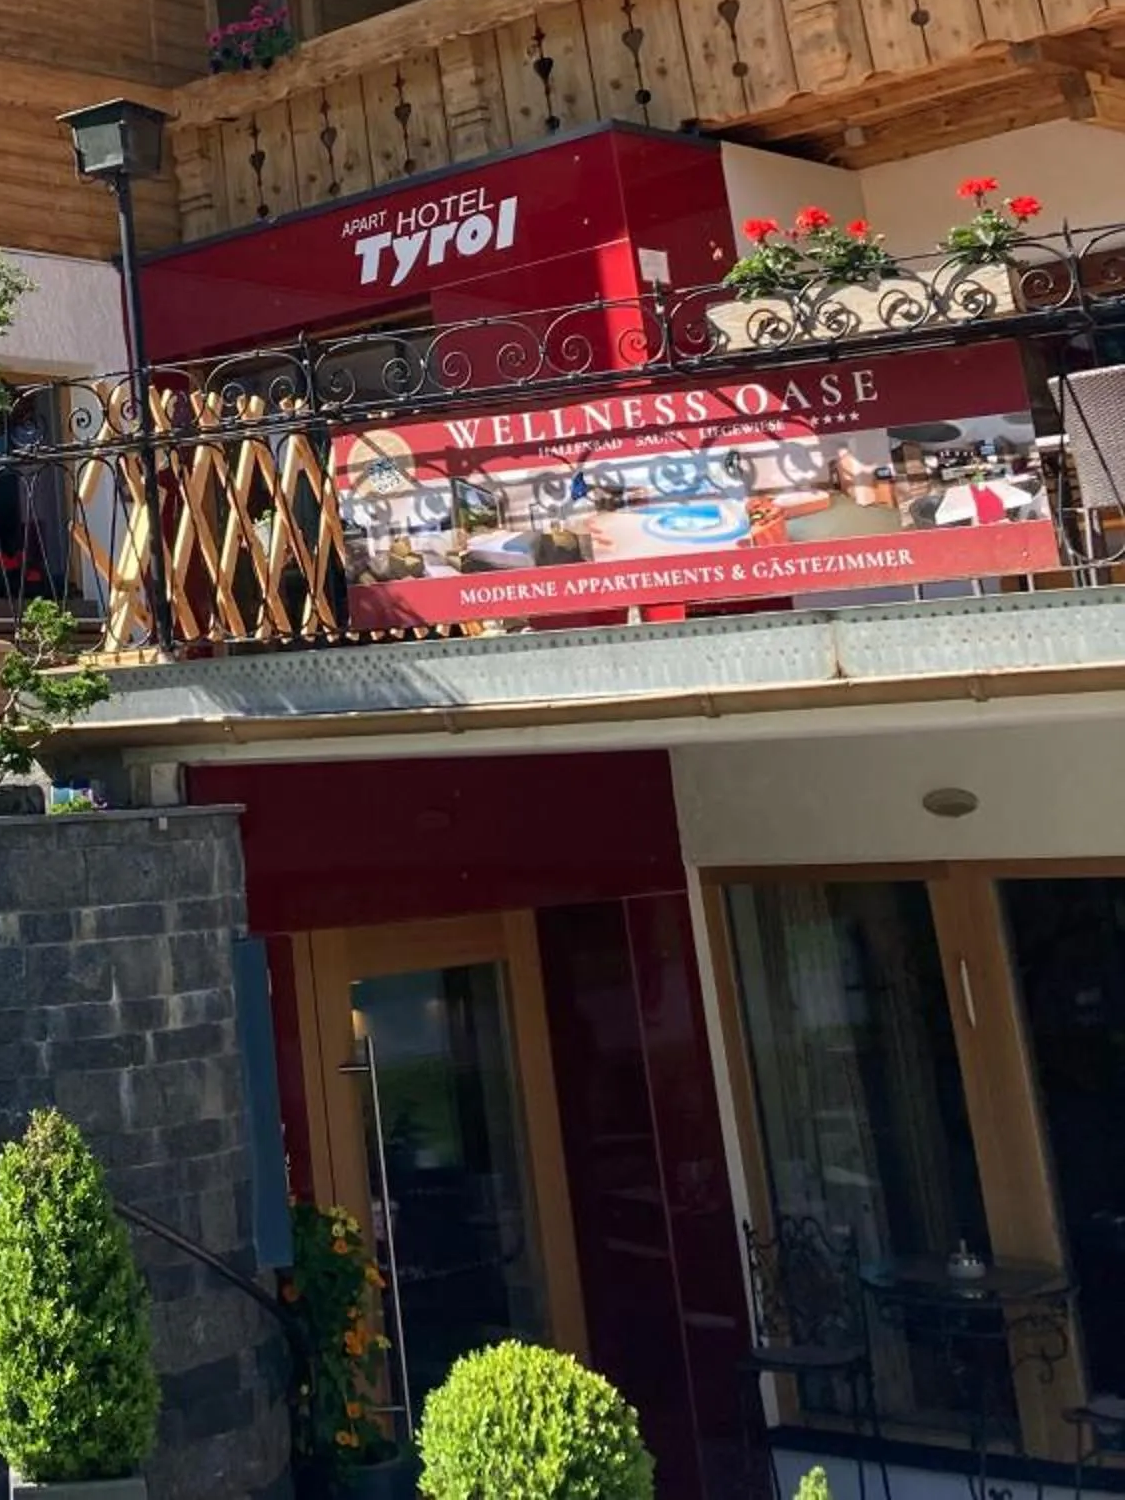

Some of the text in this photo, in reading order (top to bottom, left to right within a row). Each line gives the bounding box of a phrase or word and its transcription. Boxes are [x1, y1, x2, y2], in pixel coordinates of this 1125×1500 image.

[341, 187, 494, 238] APART HOTEL
[354, 195, 518, 287] Tyrol
[443, 369, 879, 450] WELLNESS OASE
[459, 548, 915, 606] MODERNE APPARTEMENTS & GÄSTEZIMMER
